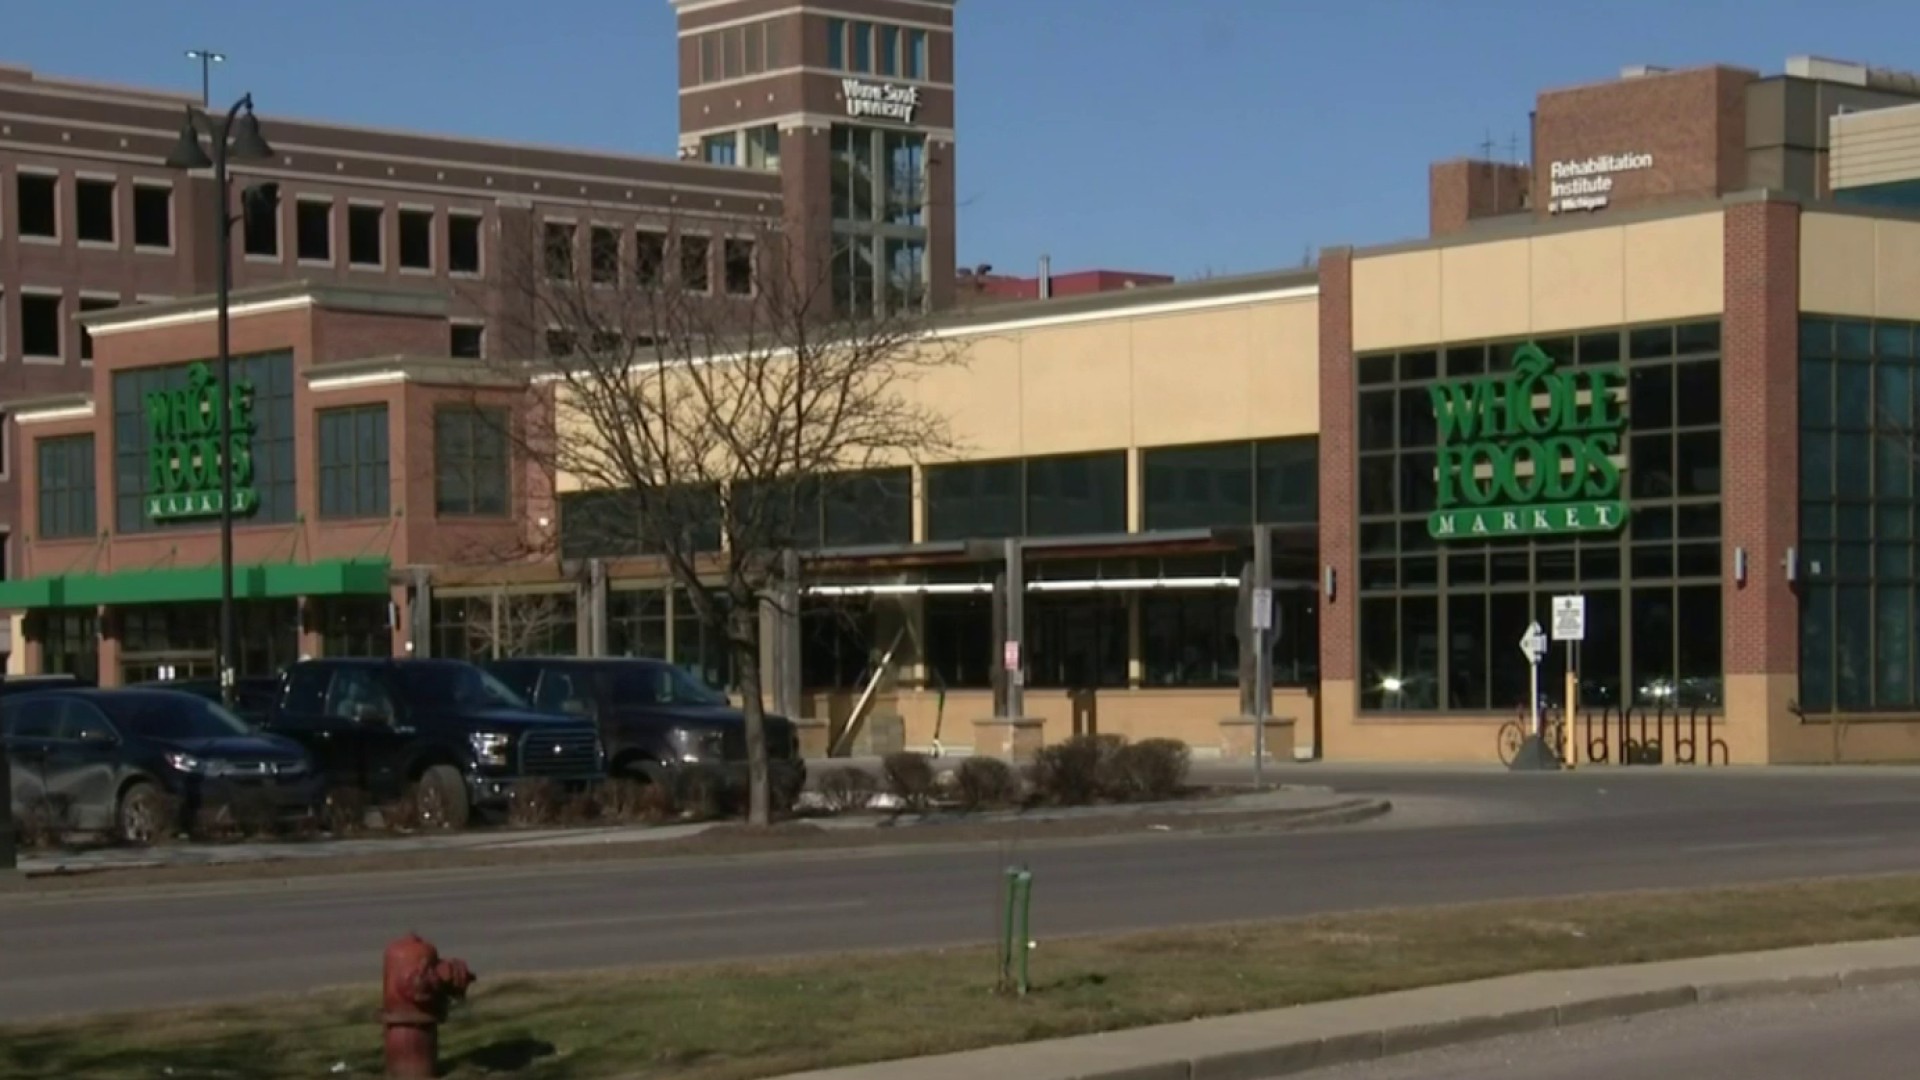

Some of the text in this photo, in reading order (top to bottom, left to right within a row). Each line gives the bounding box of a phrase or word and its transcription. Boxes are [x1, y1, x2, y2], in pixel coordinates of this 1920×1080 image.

[1551, 152, 1653, 179] Rehabilitation
[1551, 175, 1612, 197] Institute
[1429, 364, 1629, 440] WHOLE
[1436, 432, 1621, 505] FOODS
[1438, 506, 1611, 534] MARKET
